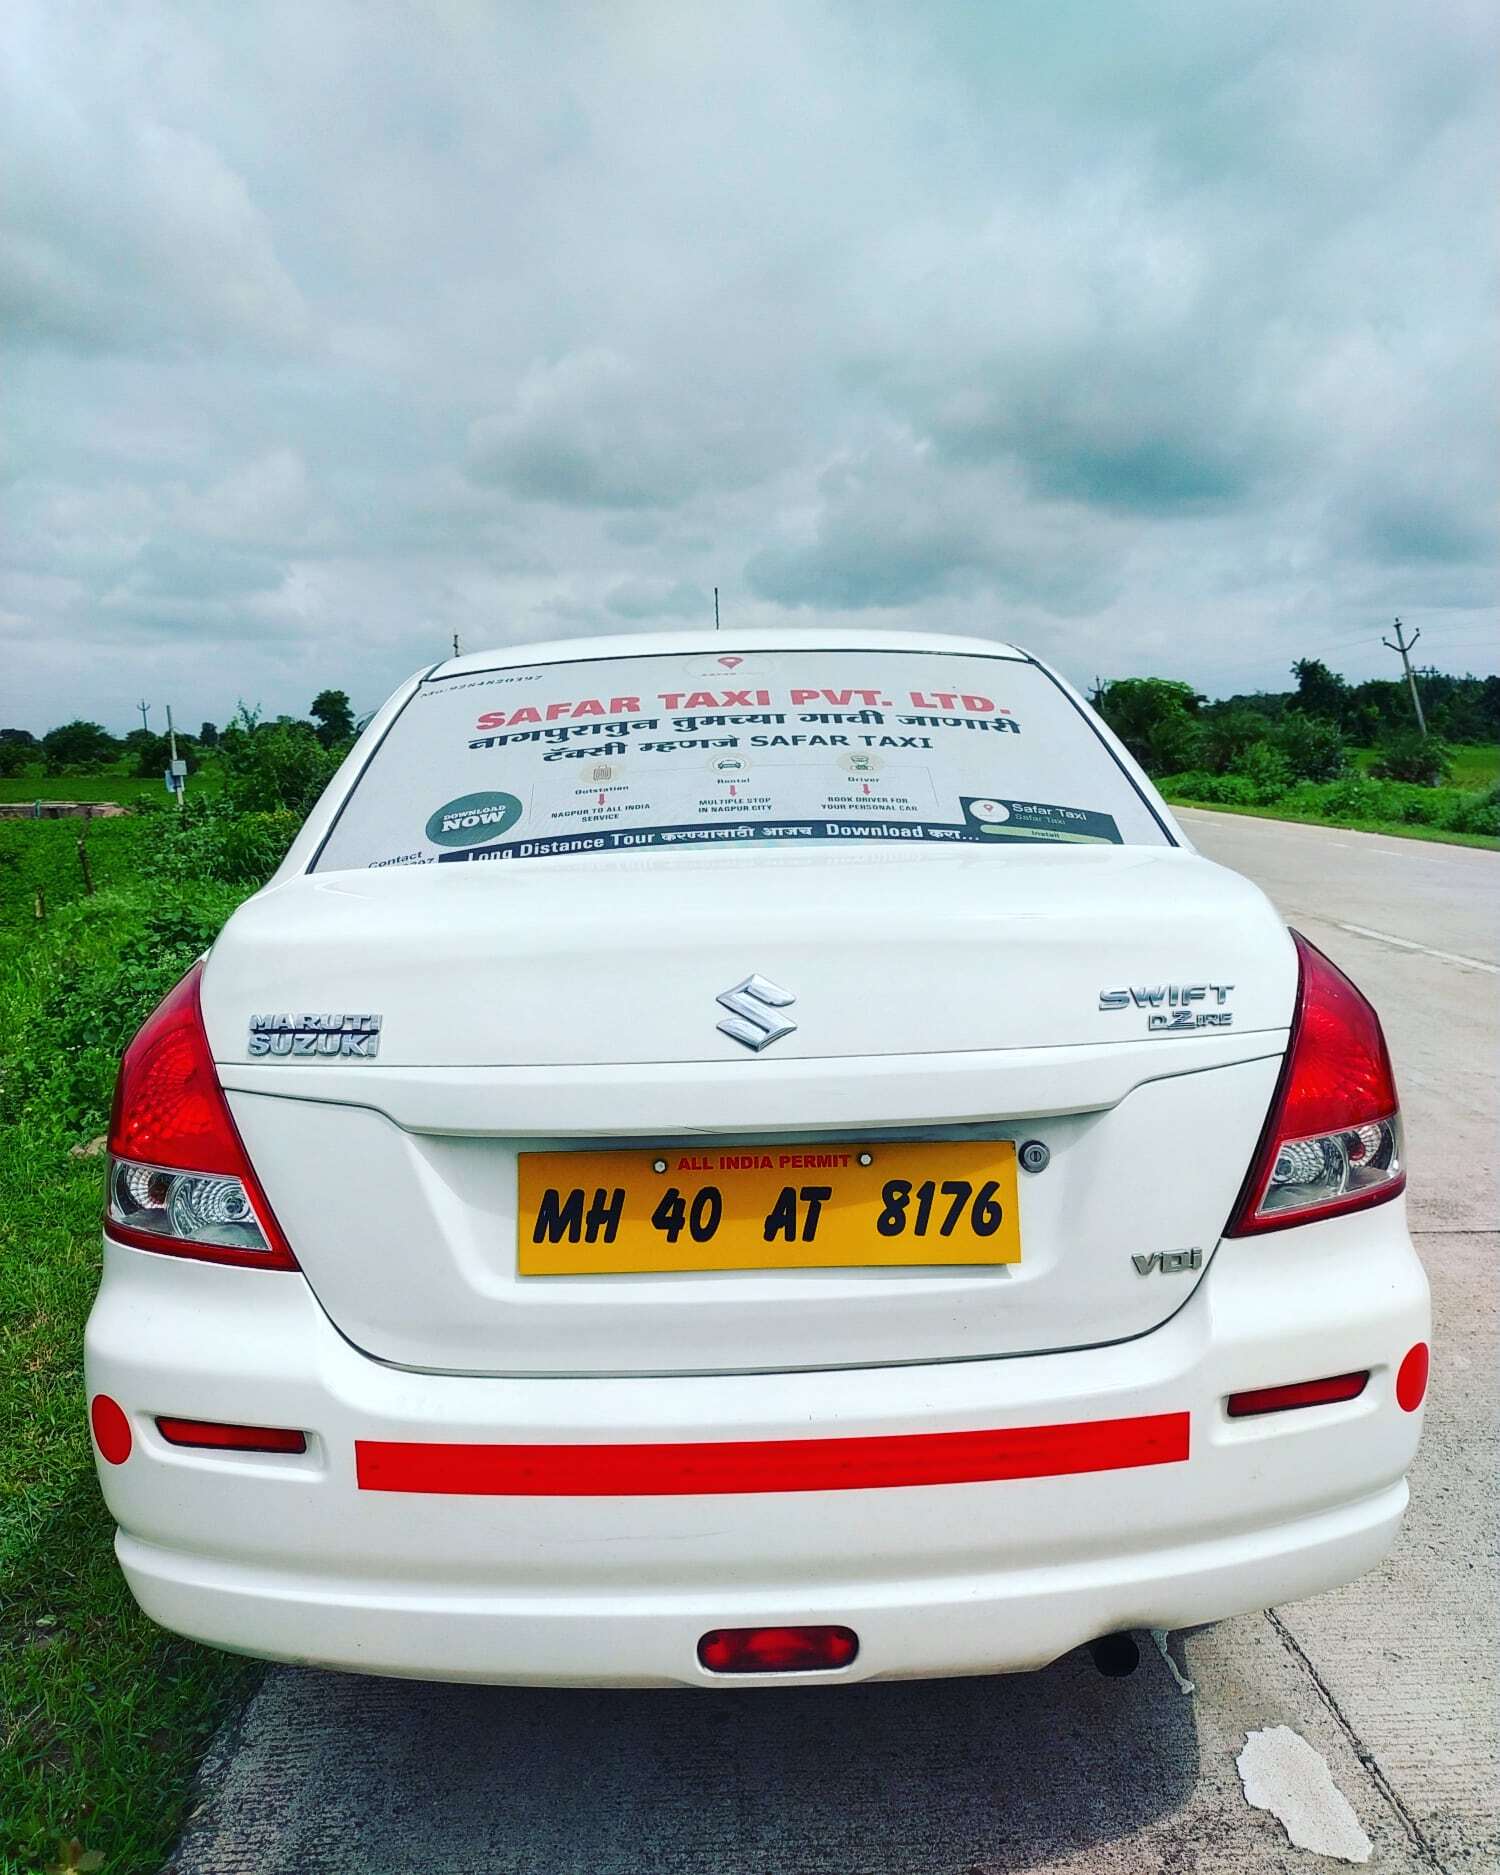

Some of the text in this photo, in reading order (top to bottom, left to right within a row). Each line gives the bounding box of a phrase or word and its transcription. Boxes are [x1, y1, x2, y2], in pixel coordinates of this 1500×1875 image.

[475, 689, 1011, 730] SAFAR TAXI PVT. LTD.
[671, 714, 788, 732] तुमच्या
[896, 715, 1022, 735] जाणारी
[639, 735, 740, 752] म्हणजे
[750, 734, 850, 748] SAFAR
[858, 735, 934, 749] TAXI
[443, 804, 507, 820] DOWNLOAD
[551, 803, 651, 819] NAGPUR TO ALL INDIA
[581, 813, 620, 823] SERVICE
[1012, 803, 1087, 821] Safar Taxi
[440, 811, 506, 832] NOW
[519, 837, 604, 857] Distance
[610, 832, 655, 846] Tour
[762, 826, 813, 837] आजच
[825, 823, 923, 838] Download
[1099, 983, 1235, 1011] SWIFT
[250, 1014, 383, 1031] MARUTI
[249, 1032, 380, 1057] SUZUKI
[678, 1153, 851, 1171] ALL INDIA PERMIT
[533, 1180, 1003, 1244] MH 40 AT 8176
